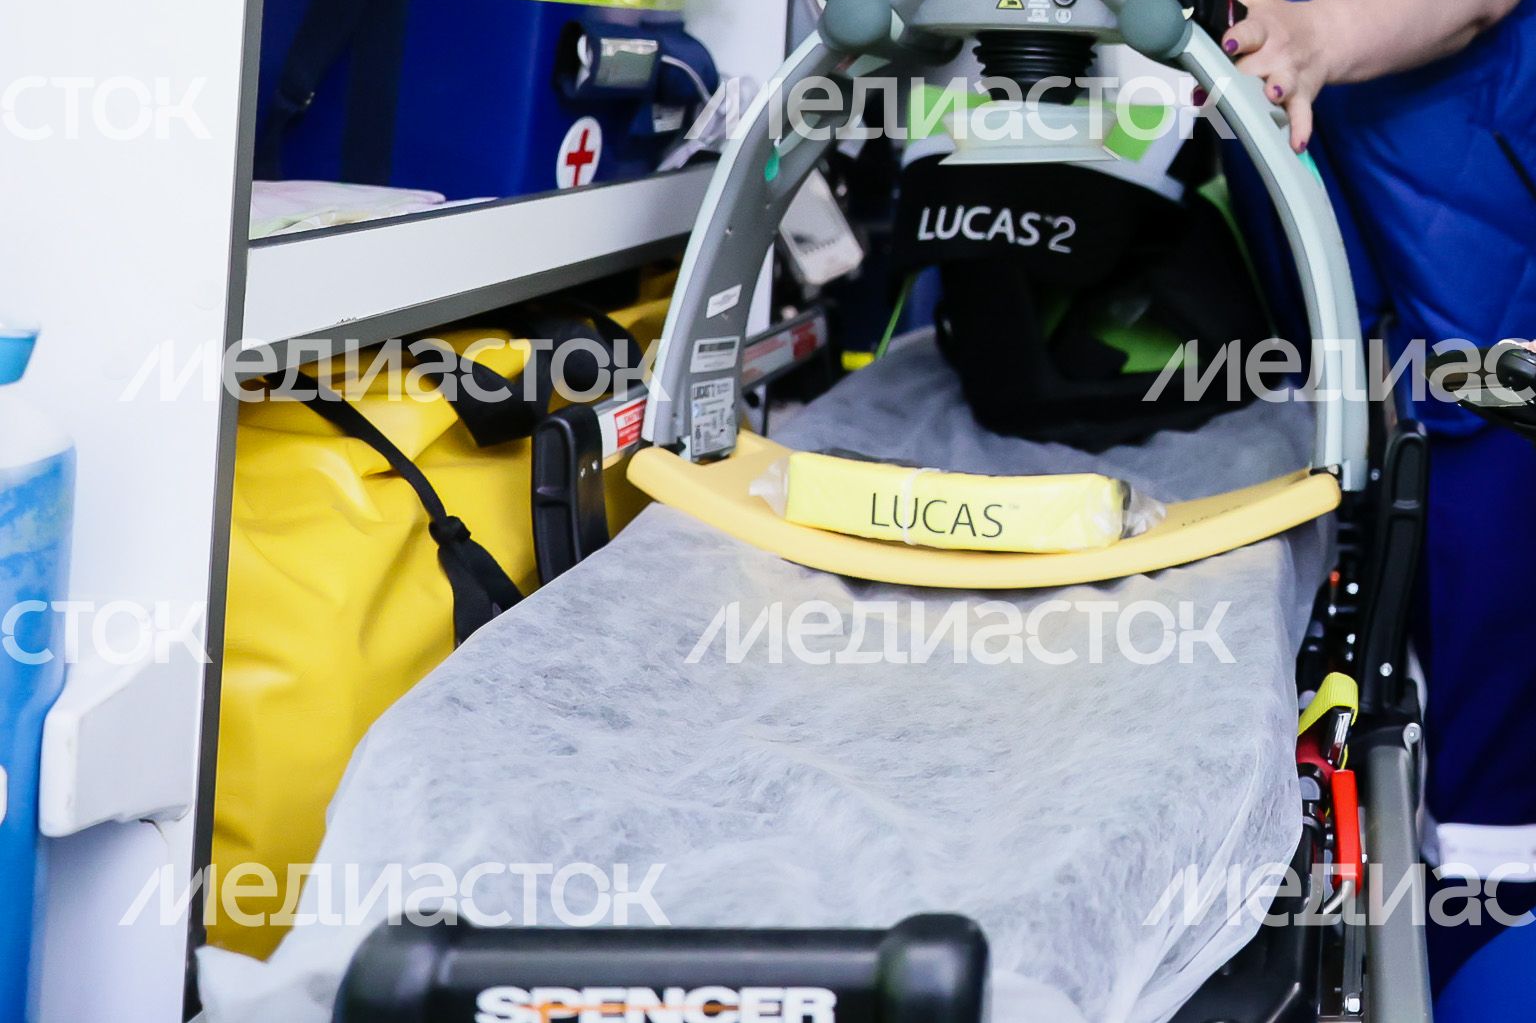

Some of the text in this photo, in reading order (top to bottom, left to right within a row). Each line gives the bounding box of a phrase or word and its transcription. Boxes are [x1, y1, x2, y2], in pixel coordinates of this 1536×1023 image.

[917, 204, 1042, 247] LUCAS
[871, 492, 1004, 539] LUCAS
[475, 986, 838, 1023] SPENCER
